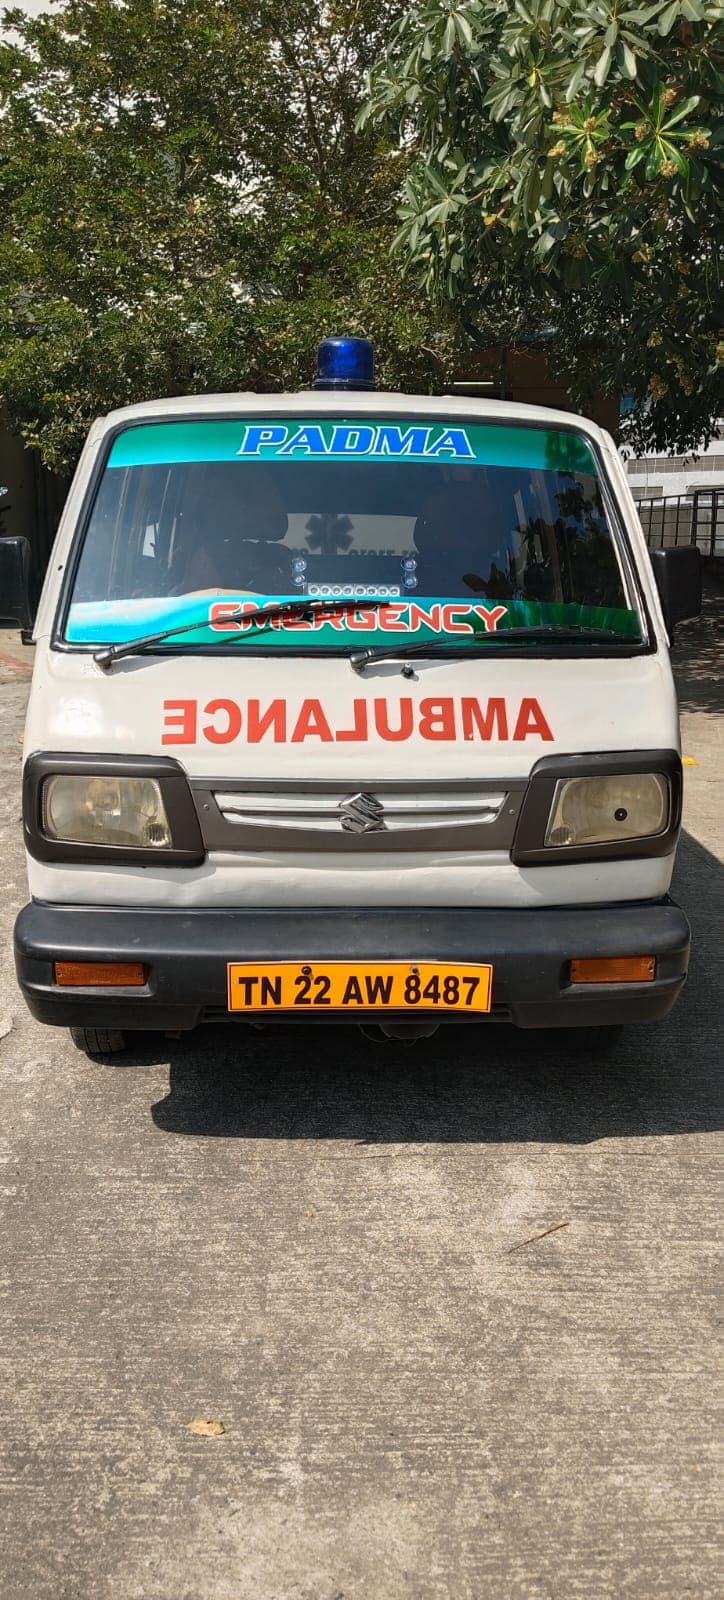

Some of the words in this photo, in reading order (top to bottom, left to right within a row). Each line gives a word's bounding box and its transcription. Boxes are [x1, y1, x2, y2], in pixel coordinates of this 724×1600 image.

[238, 425, 476, 457] PADMA
[208, 602, 507, 633] EMERGENCY
[238, 977, 282, 1005] TN
[295, 976, 331, 1004] 22
[343, 976, 393, 1004] AW
[405, 975, 480, 1005] 8487
